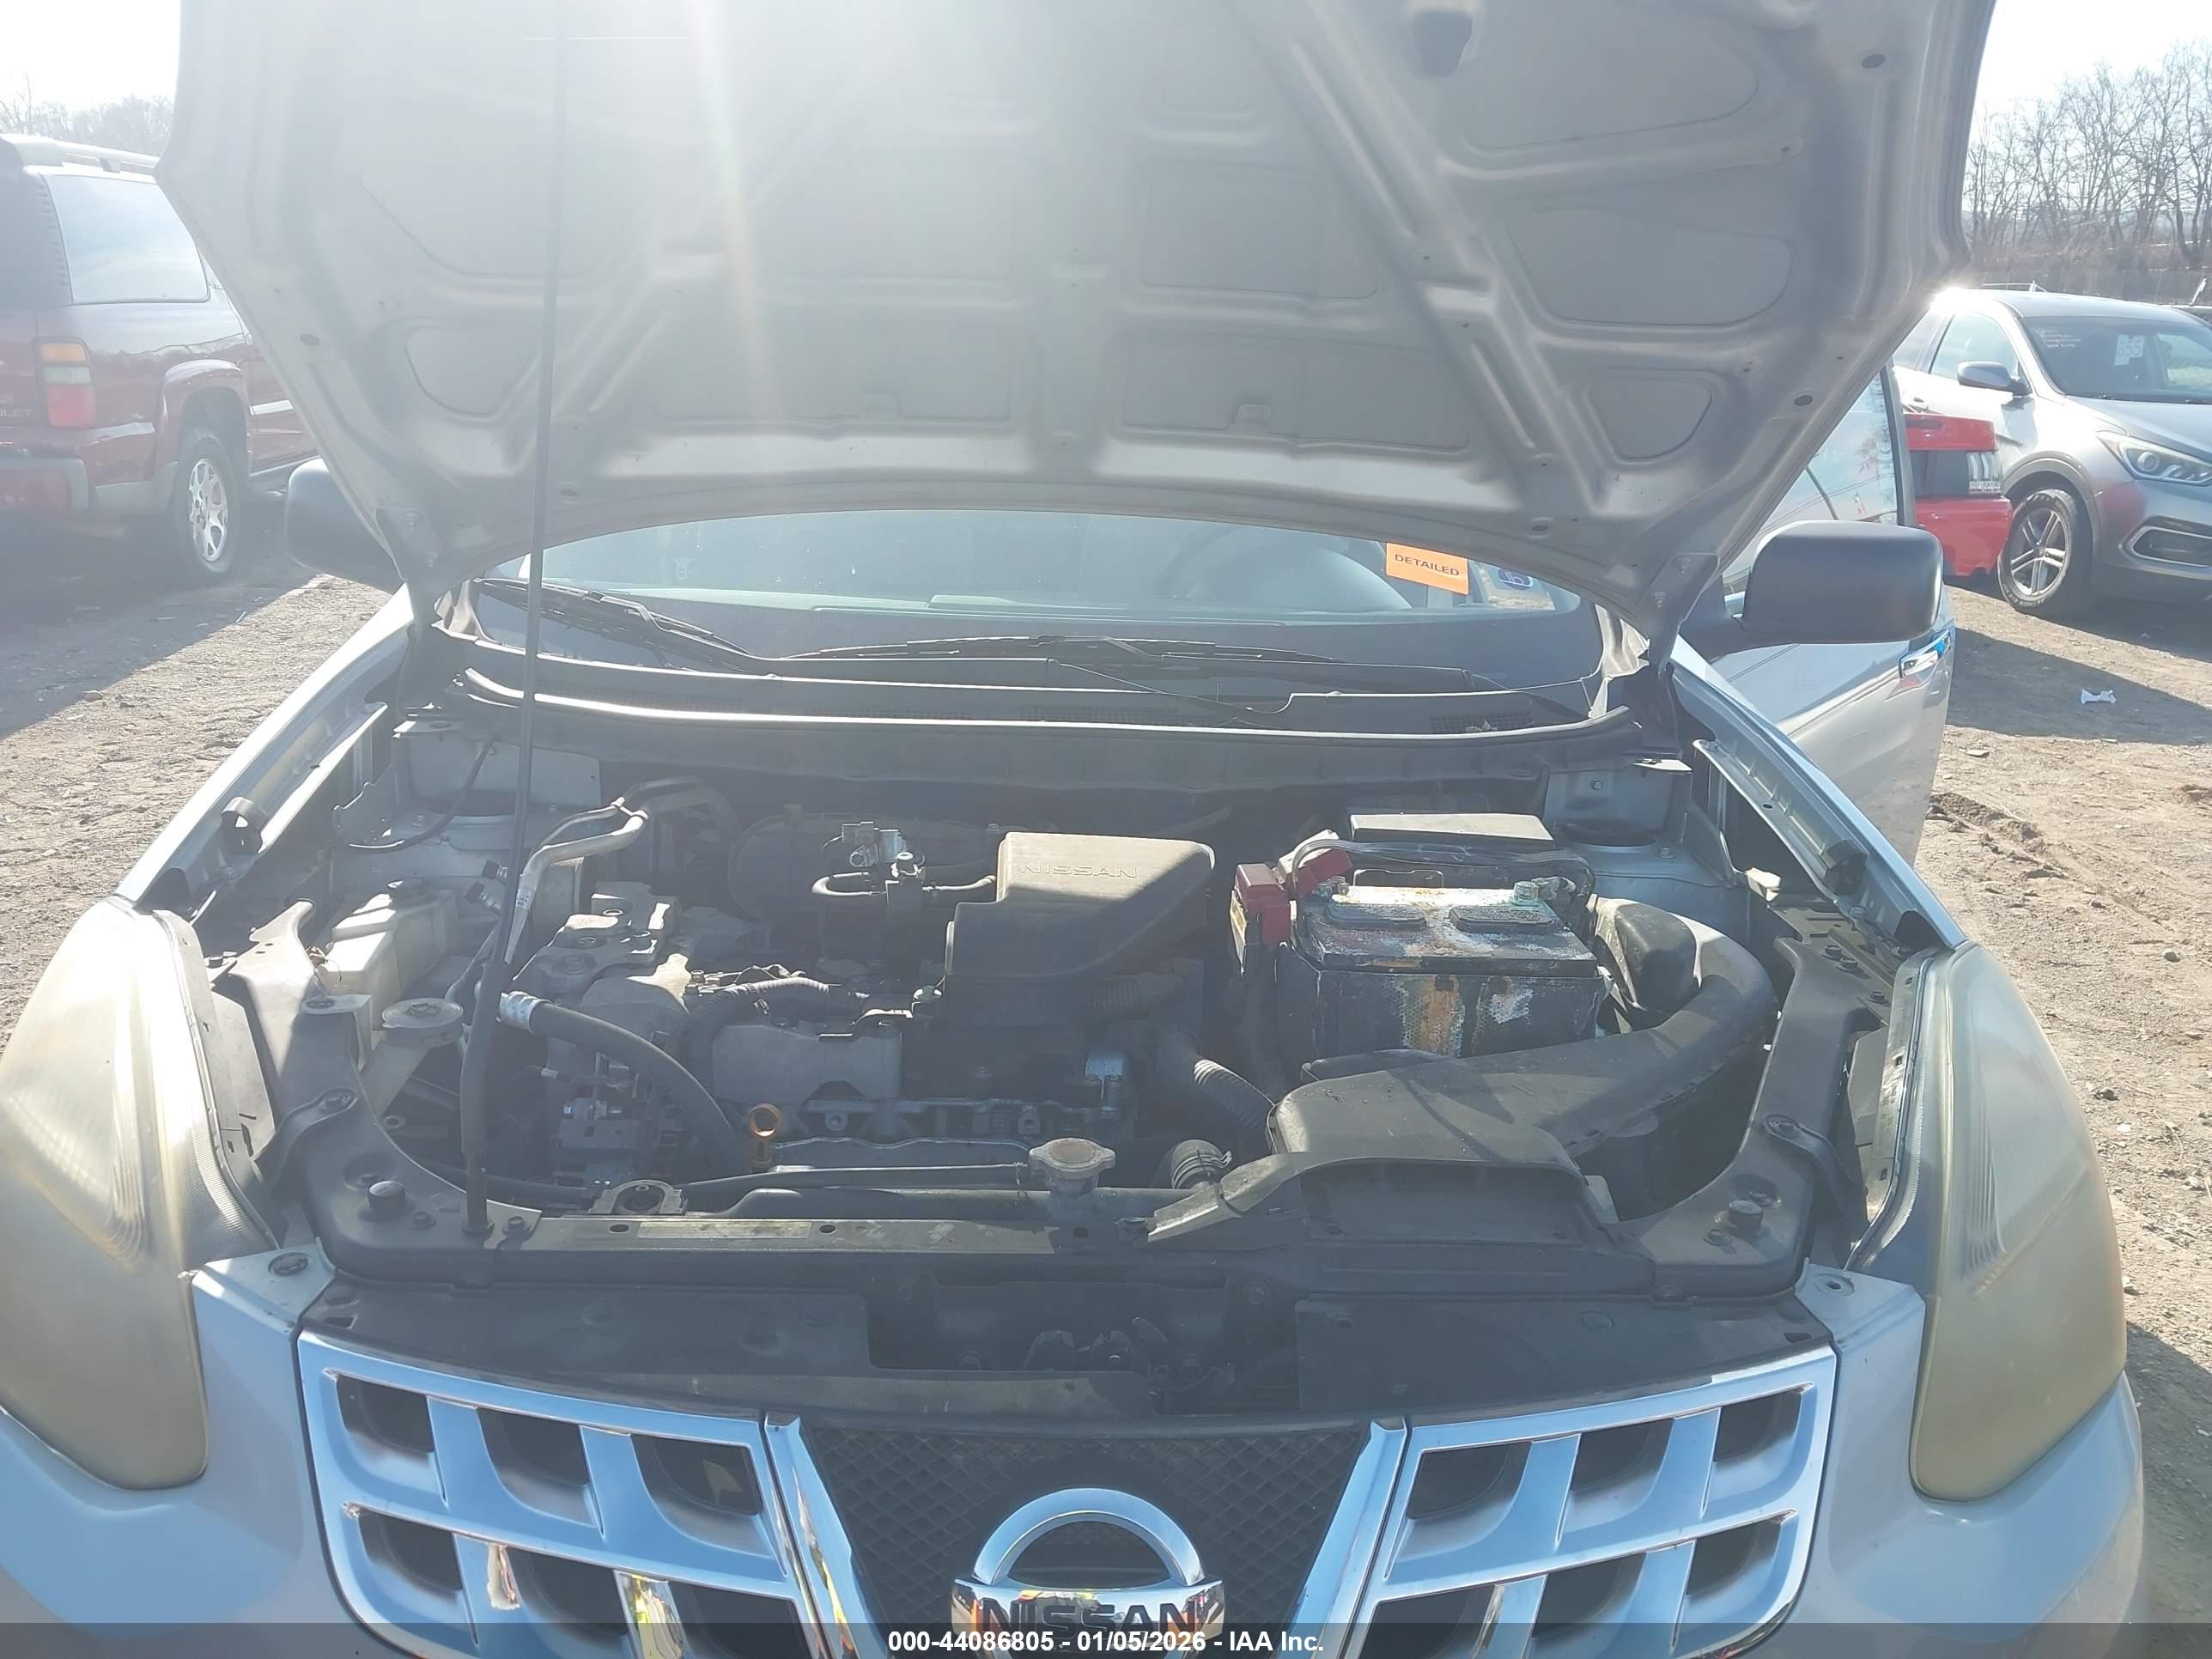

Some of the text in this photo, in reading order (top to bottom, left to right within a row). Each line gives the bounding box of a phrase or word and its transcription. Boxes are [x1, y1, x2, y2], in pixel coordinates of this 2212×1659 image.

[1395, 554, 1460, 576] DETAILED
[1019, 863, 1138, 879] NISSAN
[981, 1596, 1198, 1641] NISSAN
